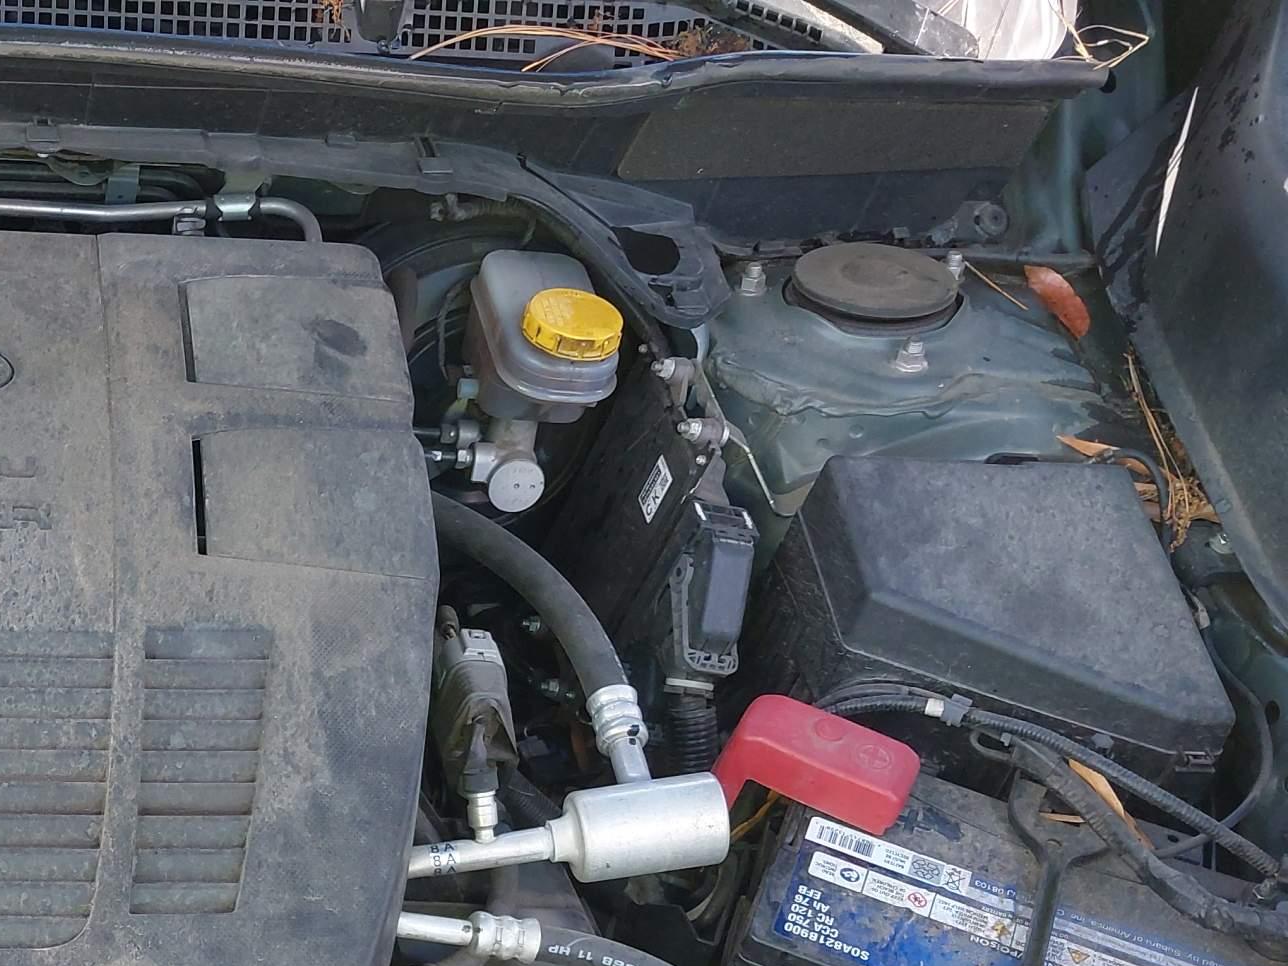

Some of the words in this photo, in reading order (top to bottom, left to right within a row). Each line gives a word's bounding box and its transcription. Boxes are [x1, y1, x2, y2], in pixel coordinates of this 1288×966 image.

[796, 883, 822, 900] EFB
[973, 878, 1005, 895] 08103
[792, 893, 811, 906] 76
[811, 899, 830, 913] Ah
[789, 902, 814, 918] 120
[786, 911, 811, 928] 750
[814, 911, 835, 926] RC
[811, 921, 840, 939] CCA
[548, 944, 571, 957] HP
[577, 949, 594, 961] 11
